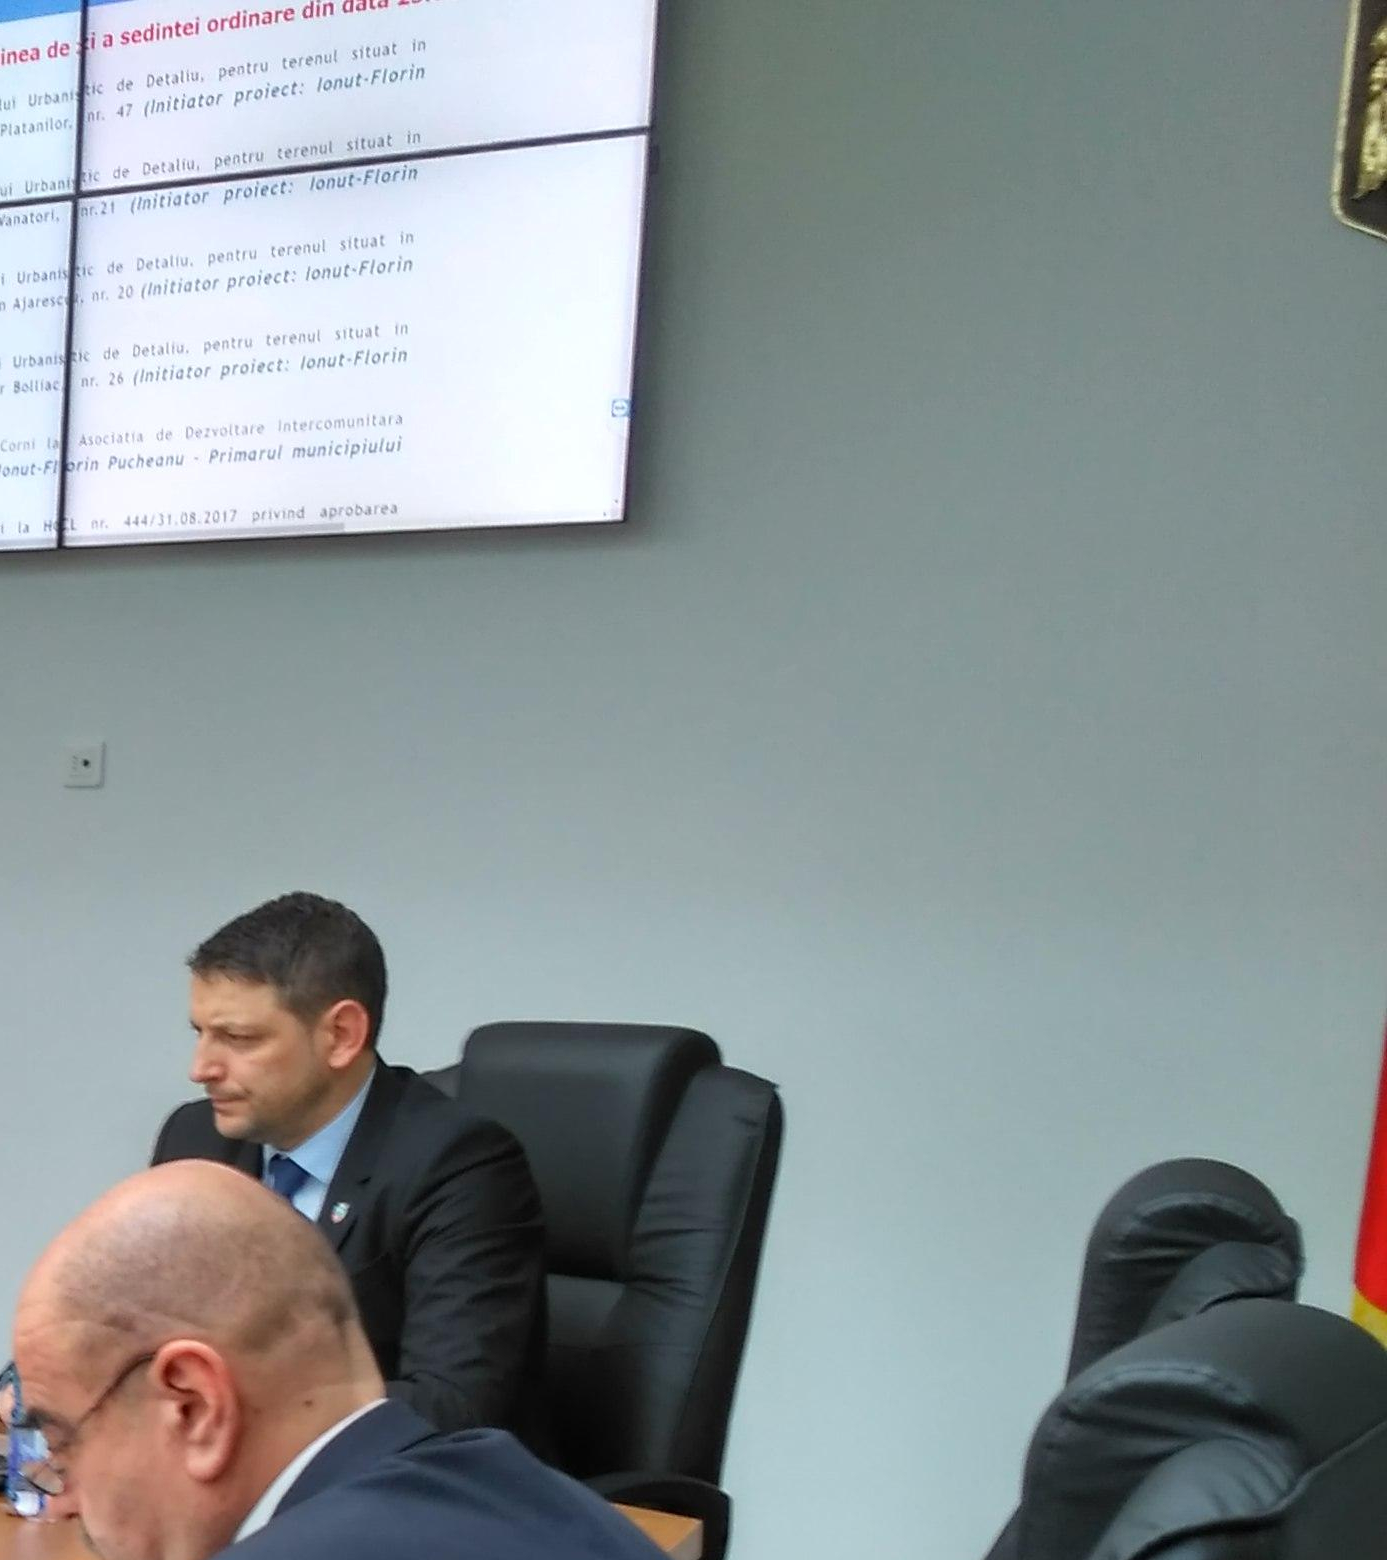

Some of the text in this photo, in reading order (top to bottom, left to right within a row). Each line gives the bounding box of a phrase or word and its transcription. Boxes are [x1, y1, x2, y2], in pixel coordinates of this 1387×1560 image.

[47, 41, 71, 59] de
[102, 33, 114, 49] a
[120, 17, 201, 45] sedintei
[207, 8, 295, 33] ordinare
[302, 0, 334, 20] din
[115, 77, 134, 93] de
[218, 60, 269, 82] pentru
[280, 48, 338, 71] terenul
[350, 41, 398, 62] situat
[410, 38, 427, 53] in
[115, 102, 133, 118] 47
[143, 93, 224, 119] (Initiator
[233, 80, 305, 108] proiect:
[316, 63, 426, 94] Ionut-Florin
[111, 165, 130, 180] de
[213, 150, 265, 172] pentru
[276, 139, 334, 161] terenul
[345, 132, 393, 154] situat
[404, 129, 421, 149] in
[129, 190, 210, 216] (Initiator
[222, 179, 294, 206] proiect:
[309, 165, 419, 193] Ionut-Florin
[106, 260, 124, 275] de
[207, 247, 258, 268] pentru
[270, 238, 327, 259] terenul
[338, 233, 386, 253] situat
[399, 229, 415, 246] in
[117, 283, 134, 300] 20
[140, 277, 220, 301] (Initiator
[226, 268, 297, 293] proiect:
[305, 254, 414, 282] Ionut-Florin
[102, 346, 120, 361] de
[203, 336, 254, 356] pentru
[265, 328, 322, 347] terenul
[334, 324, 380, 341] situat
[394, 322, 409, 337] in
[108, 371, 125, 387] 26
[132, 363, 212, 387] (Initiator
[219, 357, 290, 381] proiect:
[300, 346, 408, 371] Ionut-Florin
[78, 431, 144, 453] Asociatia
[155, 427, 173, 442] de
[185, 423, 266, 441] Dezvoltare
[277, 412, 403, 433] Intercomunitara
[107, 453, 185, 471] Pucheanu
[208, 444, 284, 465] Primarul
[291, 434, 403, 460] municipiului
[123, 508, 238, 528] 444/31.08.2017
[250, 505, 306, 523] privind
[319, 503, 398, 519] aprobarea
